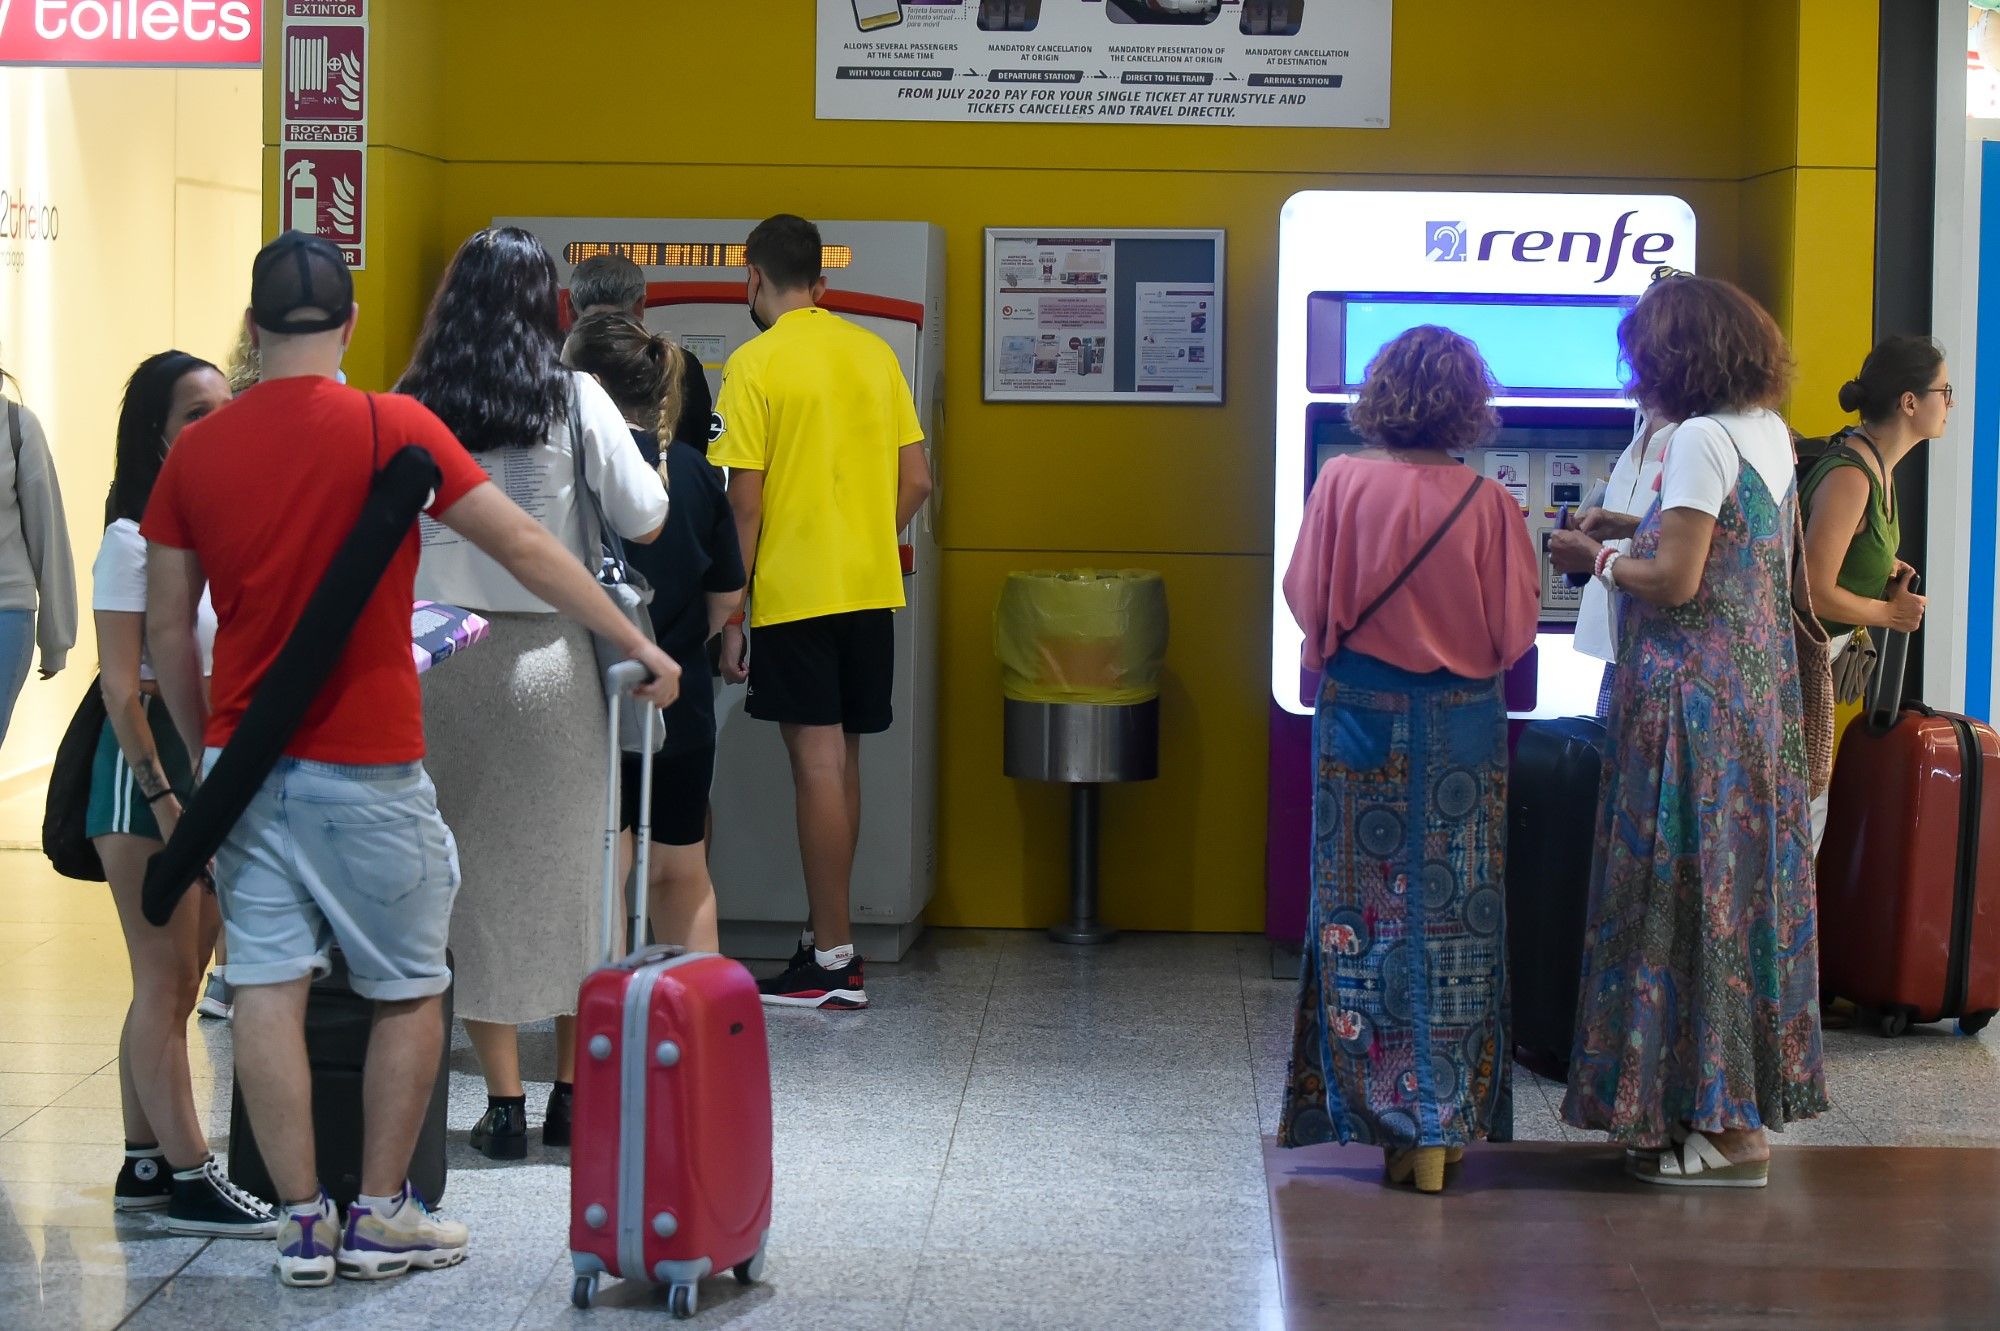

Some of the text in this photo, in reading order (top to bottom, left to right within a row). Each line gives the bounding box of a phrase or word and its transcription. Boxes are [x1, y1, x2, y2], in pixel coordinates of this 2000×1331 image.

[293, 4, 356, 15] EXTINTOR
[35, 0, 251, 41] toilets
[910, 43, 958, 51] PASSENGERS
[988, 44, 1092, 53] MANDATORY CANCELLATION
[1157, 46, 1213, 54] PRESENTATION
[1294, 49, 1349, 57] CANCELLATION
[849, 69, 868, 77] WITH
[921, 70, 942, 78] CARD
[998, 72, 1042, 80] DEPARTURE
[1154, 74, 1164, 82] TO
[1298, 77, 1329, 85] STATION
[898, 88, 1306, 104] FROM JULY 2020 PAY FOR YOUR SINGLE TICKET AT TURNSTYLE AND
[967, 103, 1236, 117] TICKETS CANCELLERS AND TRAVEL DIRECTLY.
[338, 126, 357, 134] DE
[290, 133, 357, 141] INCENDIO
[1477, 210, 1675, 284] renfe
